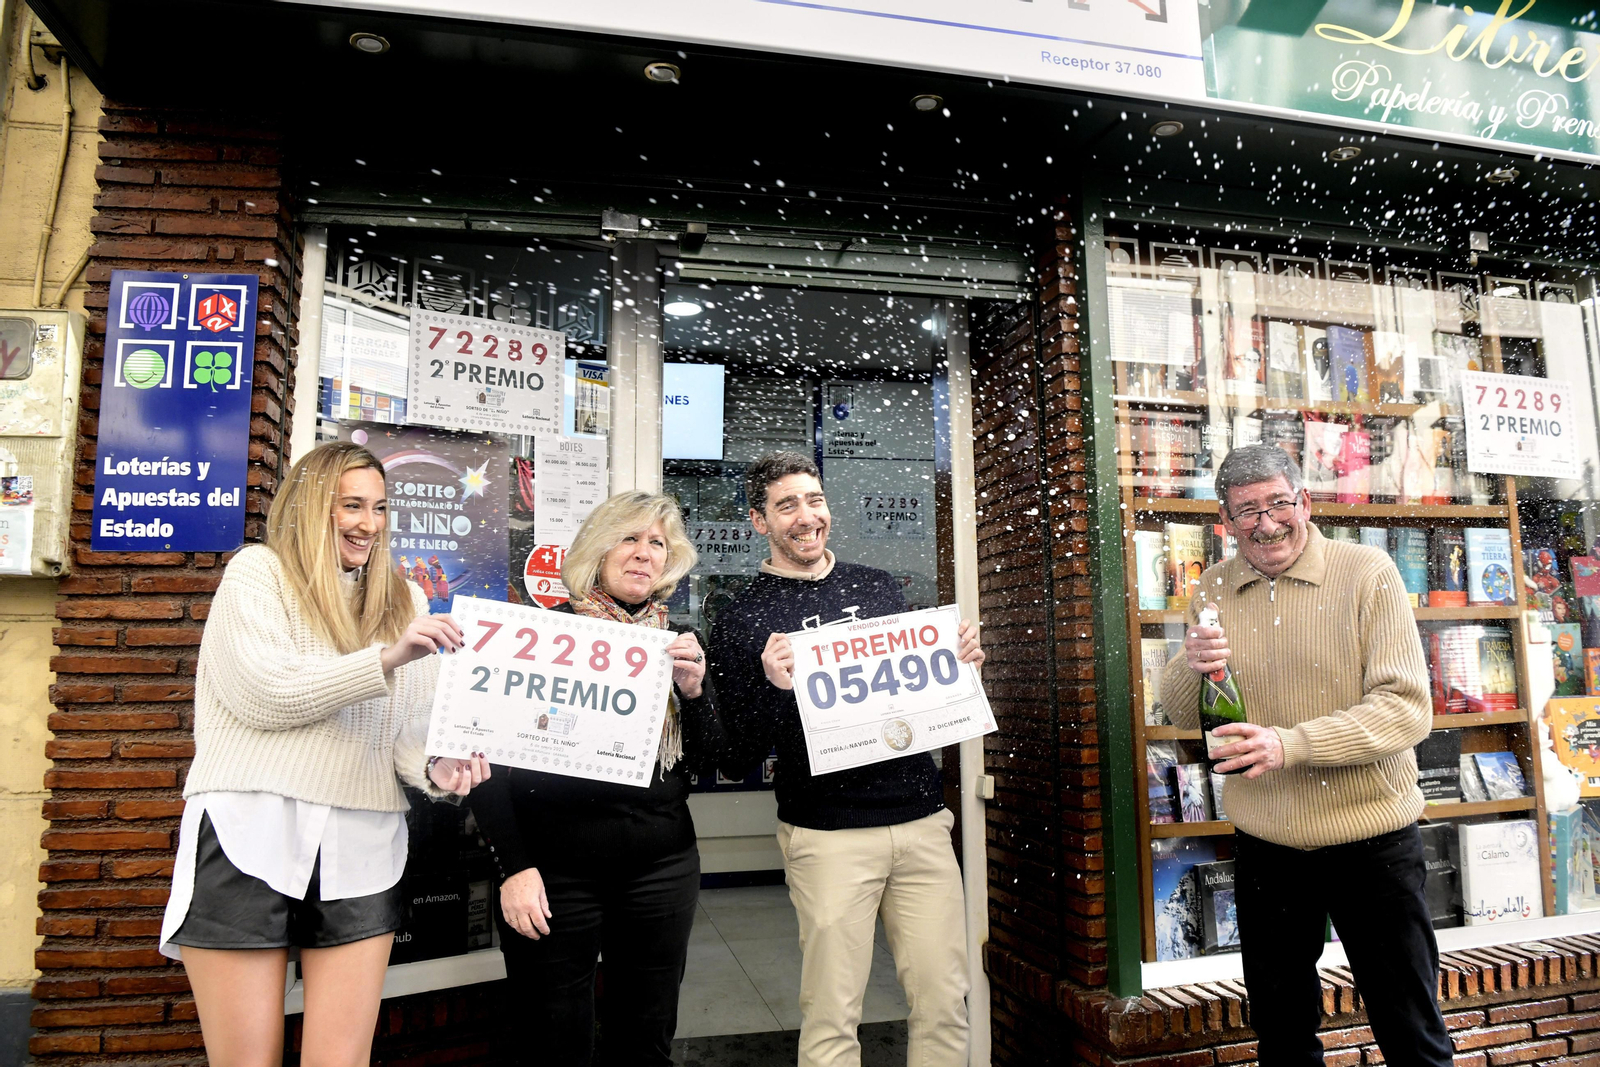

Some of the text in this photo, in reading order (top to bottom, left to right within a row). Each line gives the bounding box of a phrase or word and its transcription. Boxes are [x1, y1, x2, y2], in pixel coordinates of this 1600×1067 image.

[1314, 0, 1600, 82] Libre
[1041, 51, 1162, 79] Receptor 37.080
[1331, 60, 1483, 123] Papelería
[1480, 105, 1508, 139] y
[334, 334, 398, 350] RCARGAS
[454, 361, 544, 391] PREMIO
[582, 370, 603, 380] VISA
[663, 395, 690, 406] NES
[1475, 385, 1561, 413] 72289
[1496, 415, 1562, 437] PREMIO
[559, 442, 583, 453] BOTES
[103, 456, 211, 481] Loterías y
[394, 481, 456, 499] SORTEO
[100, 488, 240, 511] Apuestas del
[454, 503, 464, 511] DE
[99, 518, 174, 538] Estado
[390, 510, 472, 537] L NIÑO
[390, 537, 459, 551] 6 DE ENERO
[707, 543, 751, 553] PREMIO
[1481, 552, 1508, 561] TIERRA
[847, 616, 900, 632] VENDIDO AQUÍ
[471, 620, 648, 678] 72289
[832, 624, 939, 663] PREMIO
[806, 648, 960, 710] 05490
[503, 669, 637, 716] PREMIO
[937, 716, 971, 730] DICIEMBRE
[517, 732, 540, 742] SORTEO
[849, 738, 878, 750] NAVIDAD
[615, 752, 636, 761] Nacional
[1481, 850, 1510, 860] Cálamo
[1425, 859, 1451, 870] lhambra
[1204, 872, 1235, 886] Andaluc
[413, 893, 460, 905] en Amazon,
